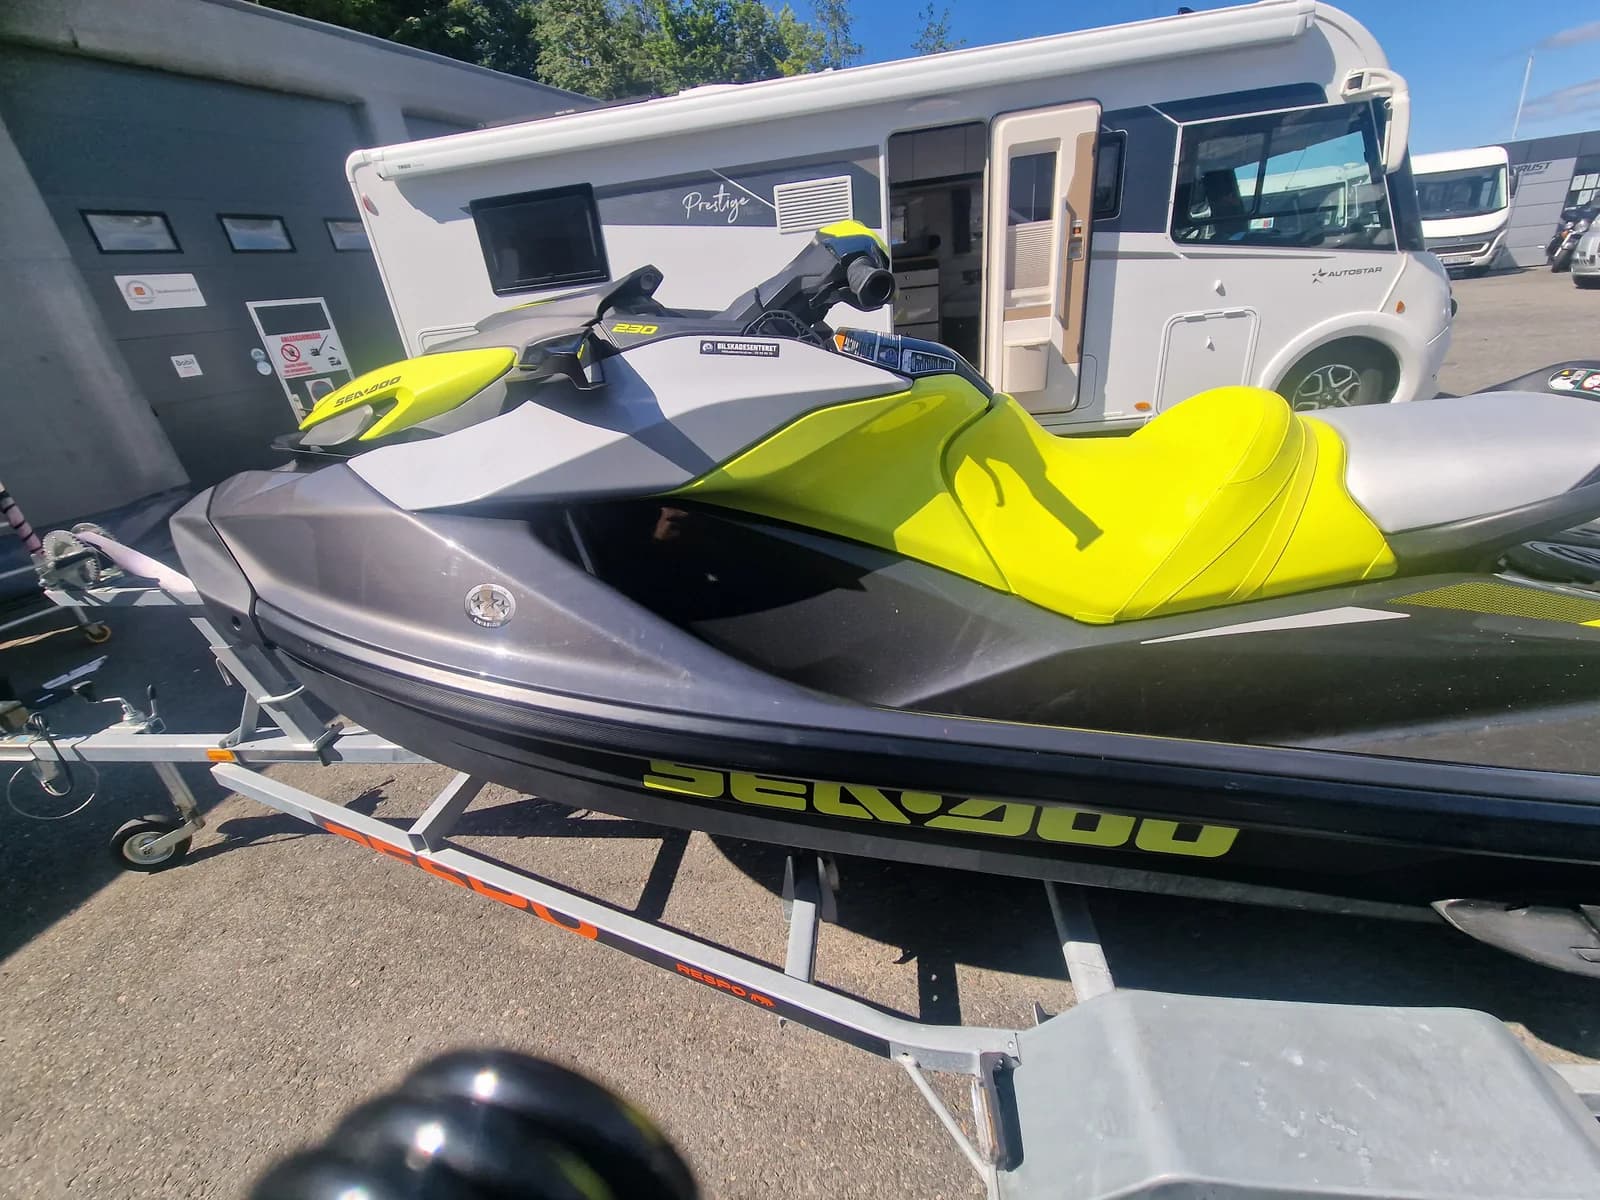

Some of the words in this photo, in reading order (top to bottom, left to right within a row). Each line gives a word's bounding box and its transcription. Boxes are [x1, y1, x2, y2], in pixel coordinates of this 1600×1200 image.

[1515, 162, 1552, 172] RUST
[682, 183, 750, 223] Prestige
[1328, 266, 1382, 277] AUTOSTAR
[611, 323, 658, 335] 230
[676, 963, 746, 997] RESPO
